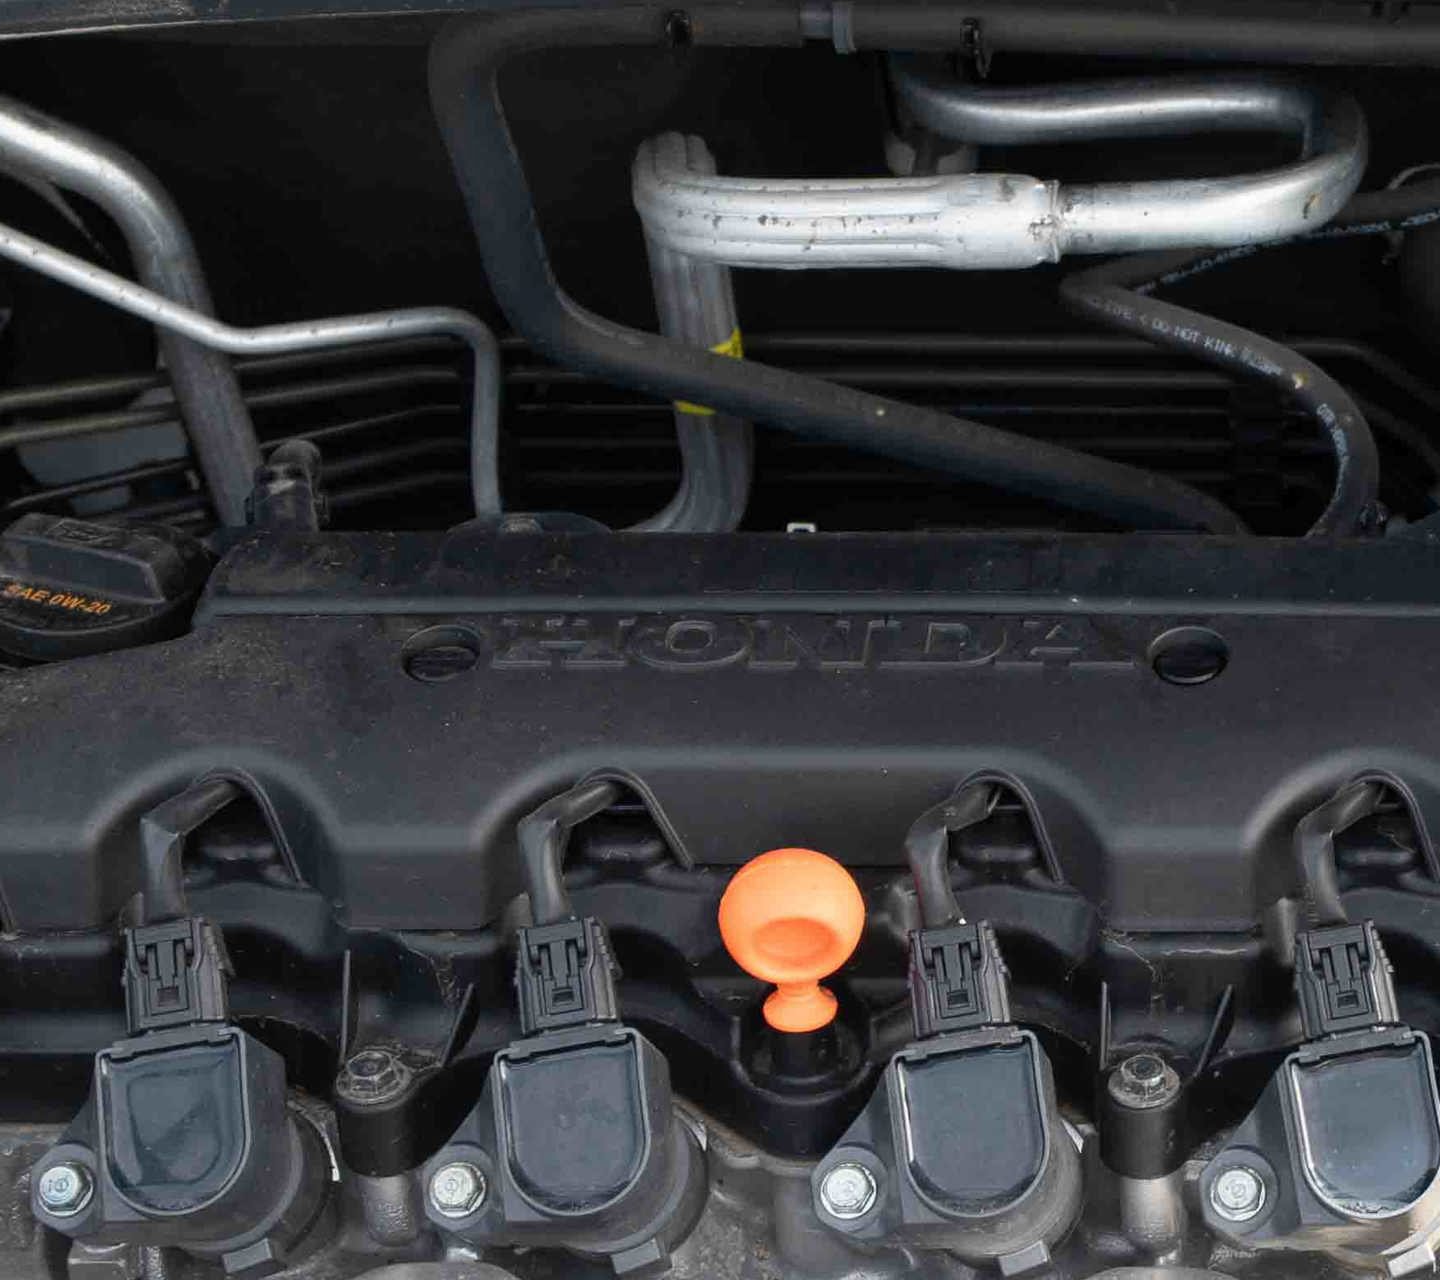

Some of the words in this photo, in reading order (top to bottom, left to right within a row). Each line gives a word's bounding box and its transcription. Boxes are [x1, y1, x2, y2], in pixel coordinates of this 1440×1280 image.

[2, 581, 48, 603] SAE
[50, 591, 112, 615] 0W-20
[489, 616, 1137, 671] HONDA
